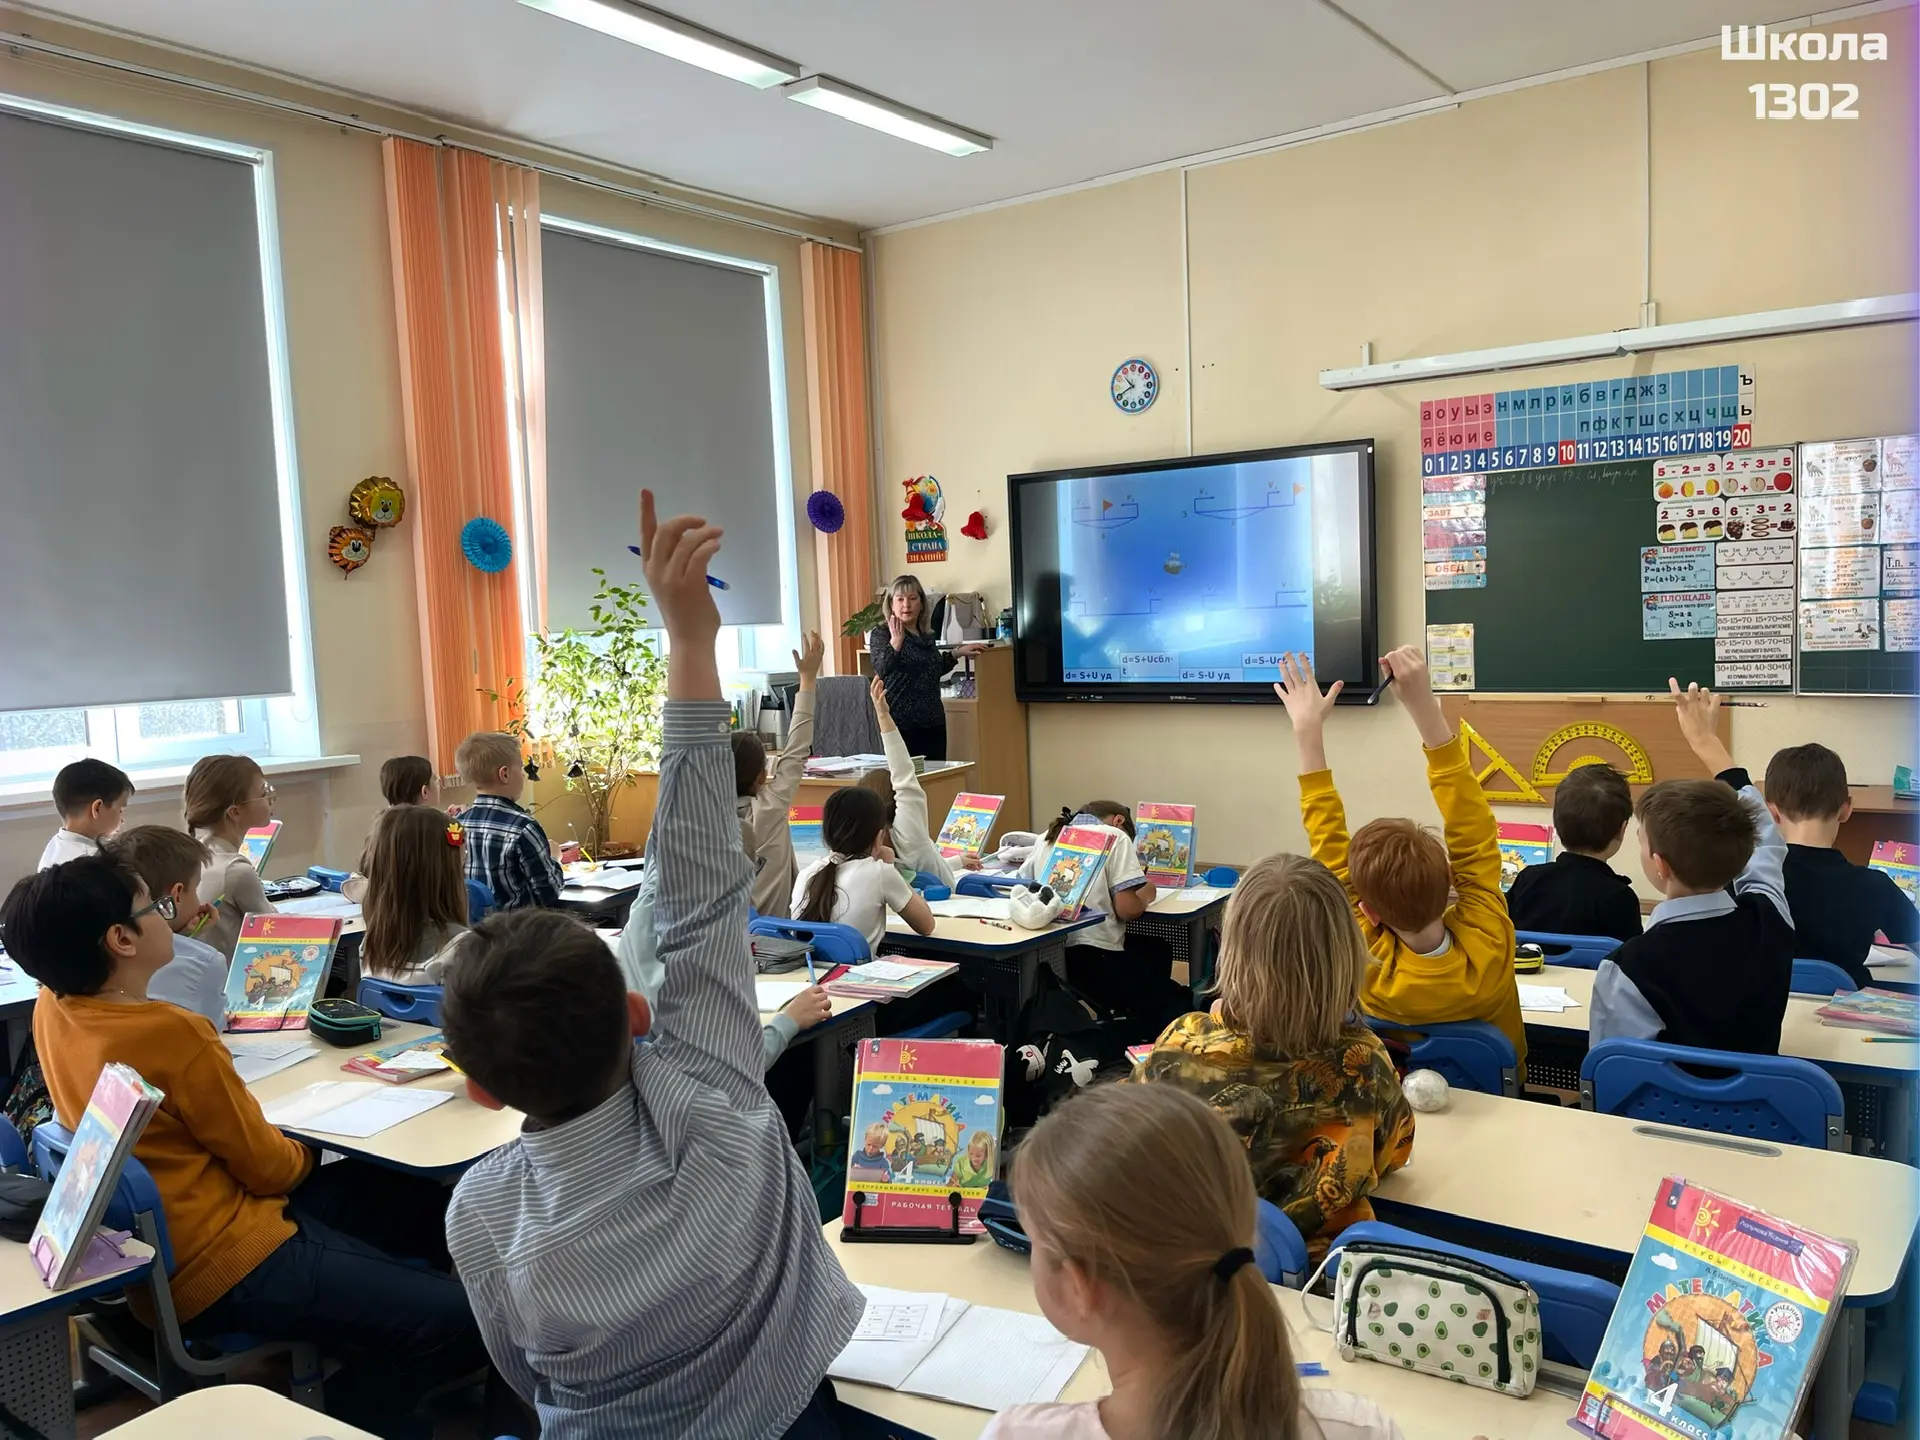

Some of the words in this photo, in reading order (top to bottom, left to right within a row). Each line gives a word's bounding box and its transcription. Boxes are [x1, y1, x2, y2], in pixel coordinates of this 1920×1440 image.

[1423, 410, 1431, 421] а
[1436, 408, 1445, 418] о
[1451, 406, 1460, 421] у
[1466, 405, 1479, 415] ы
[1484, 404, 1492, 413] э
[1498, 402, 1507, 412] н
[1513, 400, 1525, 410] м
[1530, 398, 1540, 409] л
[1546, 396, 1556, 411] р
[1563, 392, 1572, 405] й
[1424, 437, 1432, 448] я
[1437, 433, 1445, 446] ё
[1450, 434, 1462, 444] ю
[1468, 433, 1476, 443] и
[1484, 431, 1492, 441] е
[1425, 458, 1432, 473] 0
[1439, 457, 1444, 472] 1
[1451, 456, 1458, 471] 2
[1464, 455, 1471, 469] 3
[1477, 453, 1486, 468] 4
[1492, 452, 1499, 467] 5
[1505, 450, 1513, 466] 6
[1519, 449, 1527, 464] 7
[1533, 448, 1541, 463] 8
[1548, 446, 1556, 462] 9
[1561, 445, 1574, 461] 10
[1577, 443, 1589, 459] 11
[1593, 441, 1607, 458] 12
[1610, 440, 1624, 456] 13
[1628, 438, 1642, 455] 14
[1645, 437, 1659, 453] 15
[1663, 435, 1677, 452] 16
[1680, 433, 1695, 450] 17
[1698, 432, 1712, 448] 18
[1716, 430, 1731, 447] 19
[1733, 428, 1750, 447] 20
[1658, 468, 1665, 476] 5
[1682, 466, 1690, 474] 2
[1708, 463, 1715, 471] 3
[1726, 461, 1734, 470] 2
[1756, 459, 1764, 468] 3
[1783, 457, 1791, 466] 5
[1661, 511, 1668, 519] 2
[1687, 509, 1694, 517] 3
[1712, 507, 1720, 516] 6
[1730, 507, 1738, 516] 6
[1757, 505, 1765, 513] 3
[1784, 503, 1792, 512] 2
[912, 542, 942, 551] СТРАНА
[1662, 546, 1706, 554] Периметр
[1435, 564, 1465, 573] ОБЕД
[1660, 593, 1711, 602] ПЛОЩАДЬ
[882, 1092, 967, 1131] МАТЕМАТИКА
[900, 1161, 914, 1184] 4
[892, 1202, 932, 1210] РАБОЧАЯ
[936, 1204, 976, 1213] ТЕТАДЬ
[1646, 1278, 1773, 1368] МАТЕМАТИКА
[1649, 1383, 1678, 1416] 4
[1670, 1415, 1709, 1440] класс
